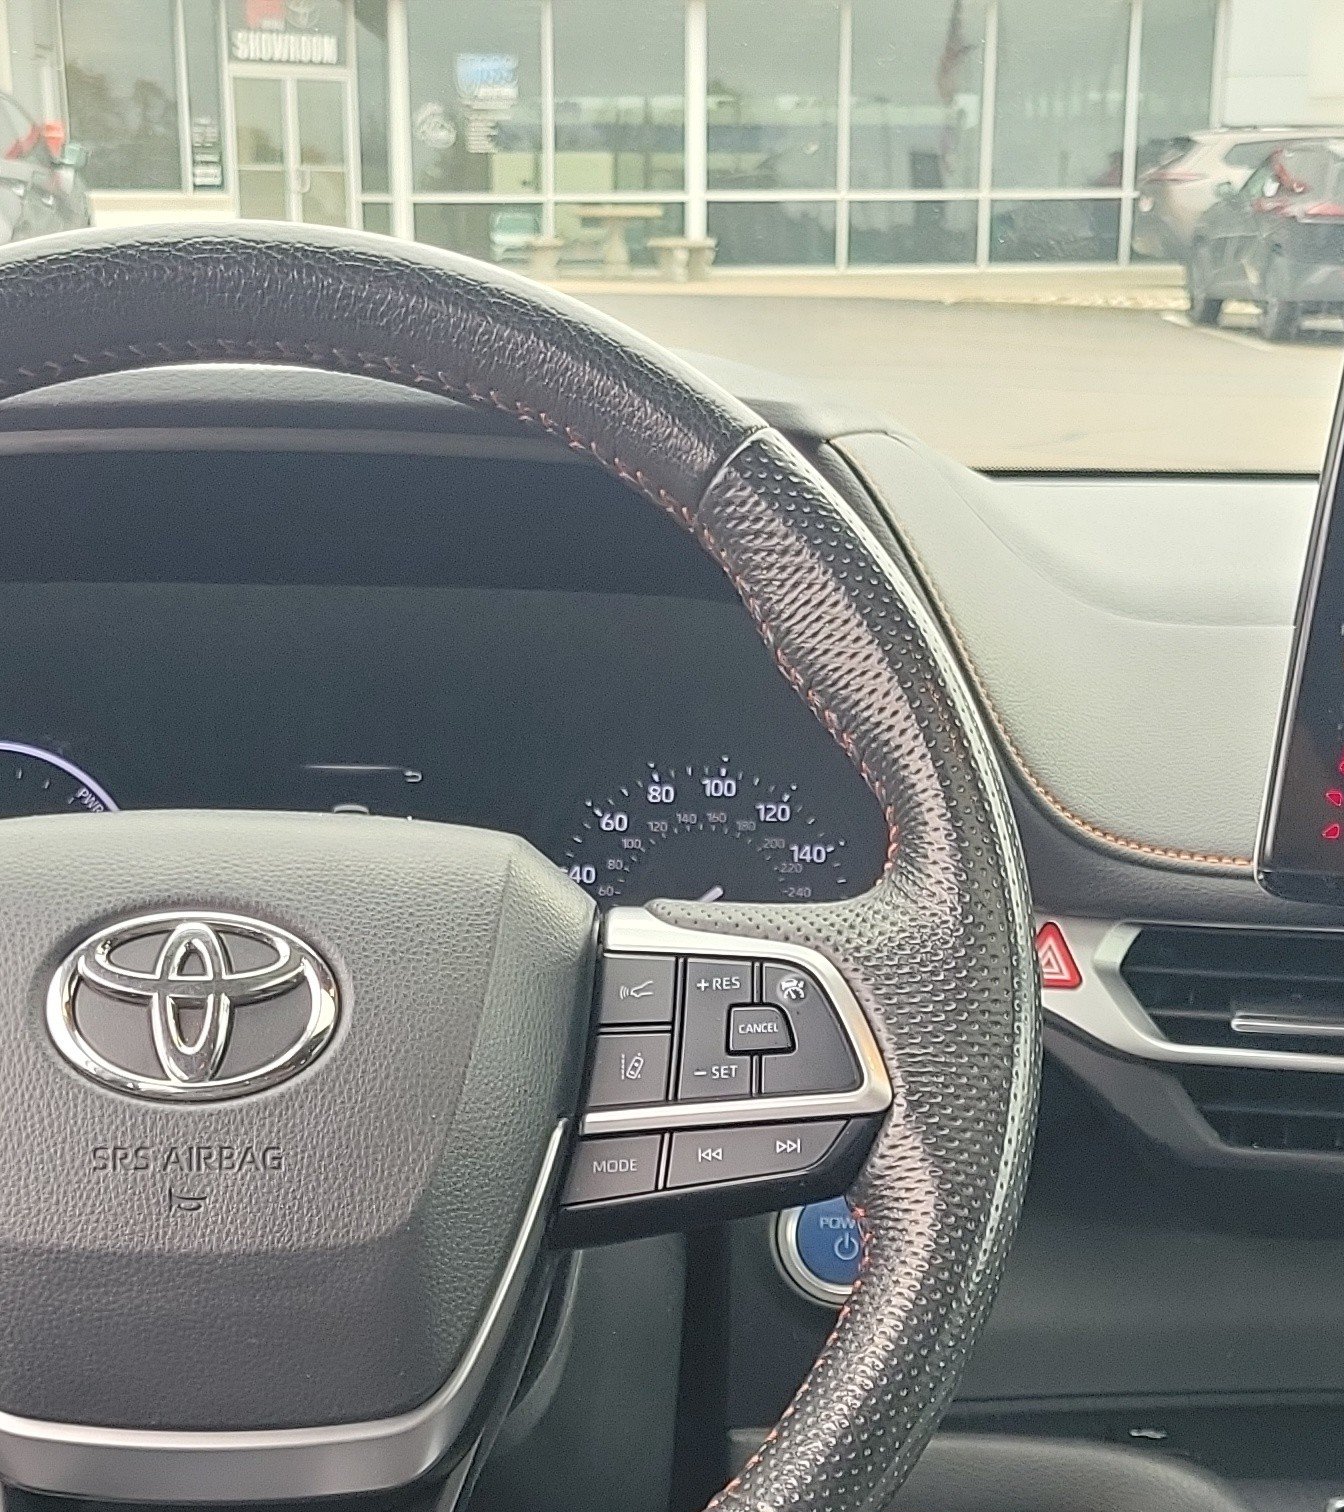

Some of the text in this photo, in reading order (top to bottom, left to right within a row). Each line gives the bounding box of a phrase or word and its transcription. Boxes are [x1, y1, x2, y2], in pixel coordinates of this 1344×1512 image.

[75, 788, 104, 813] PWR
[676, 813, 698, 825] 140
[706, 812, 727, 825] 160
[569, 779, 826, 884] 40 60 80 100 120 140
[647, 821, 668, 833] 120
[621, 838, 642, 850] 100
[764, 838, 785, 850] 200
[607, 859, 624, 871] 80
[780, 862, 803, 875] 220
[598, 885, 615, 897] 60
[788, 886, 812, 898] 240
[712, 977, 741, 990] RES
[738, 1022, 779, 1034] CANCEL
[711, 1065, 739, 1079] SET
[91, 1146, 284, 1172] SRS AIRBAG
[592, 1159, 639, 1173] MODE
[819, 1216, 856, 1230] POW
